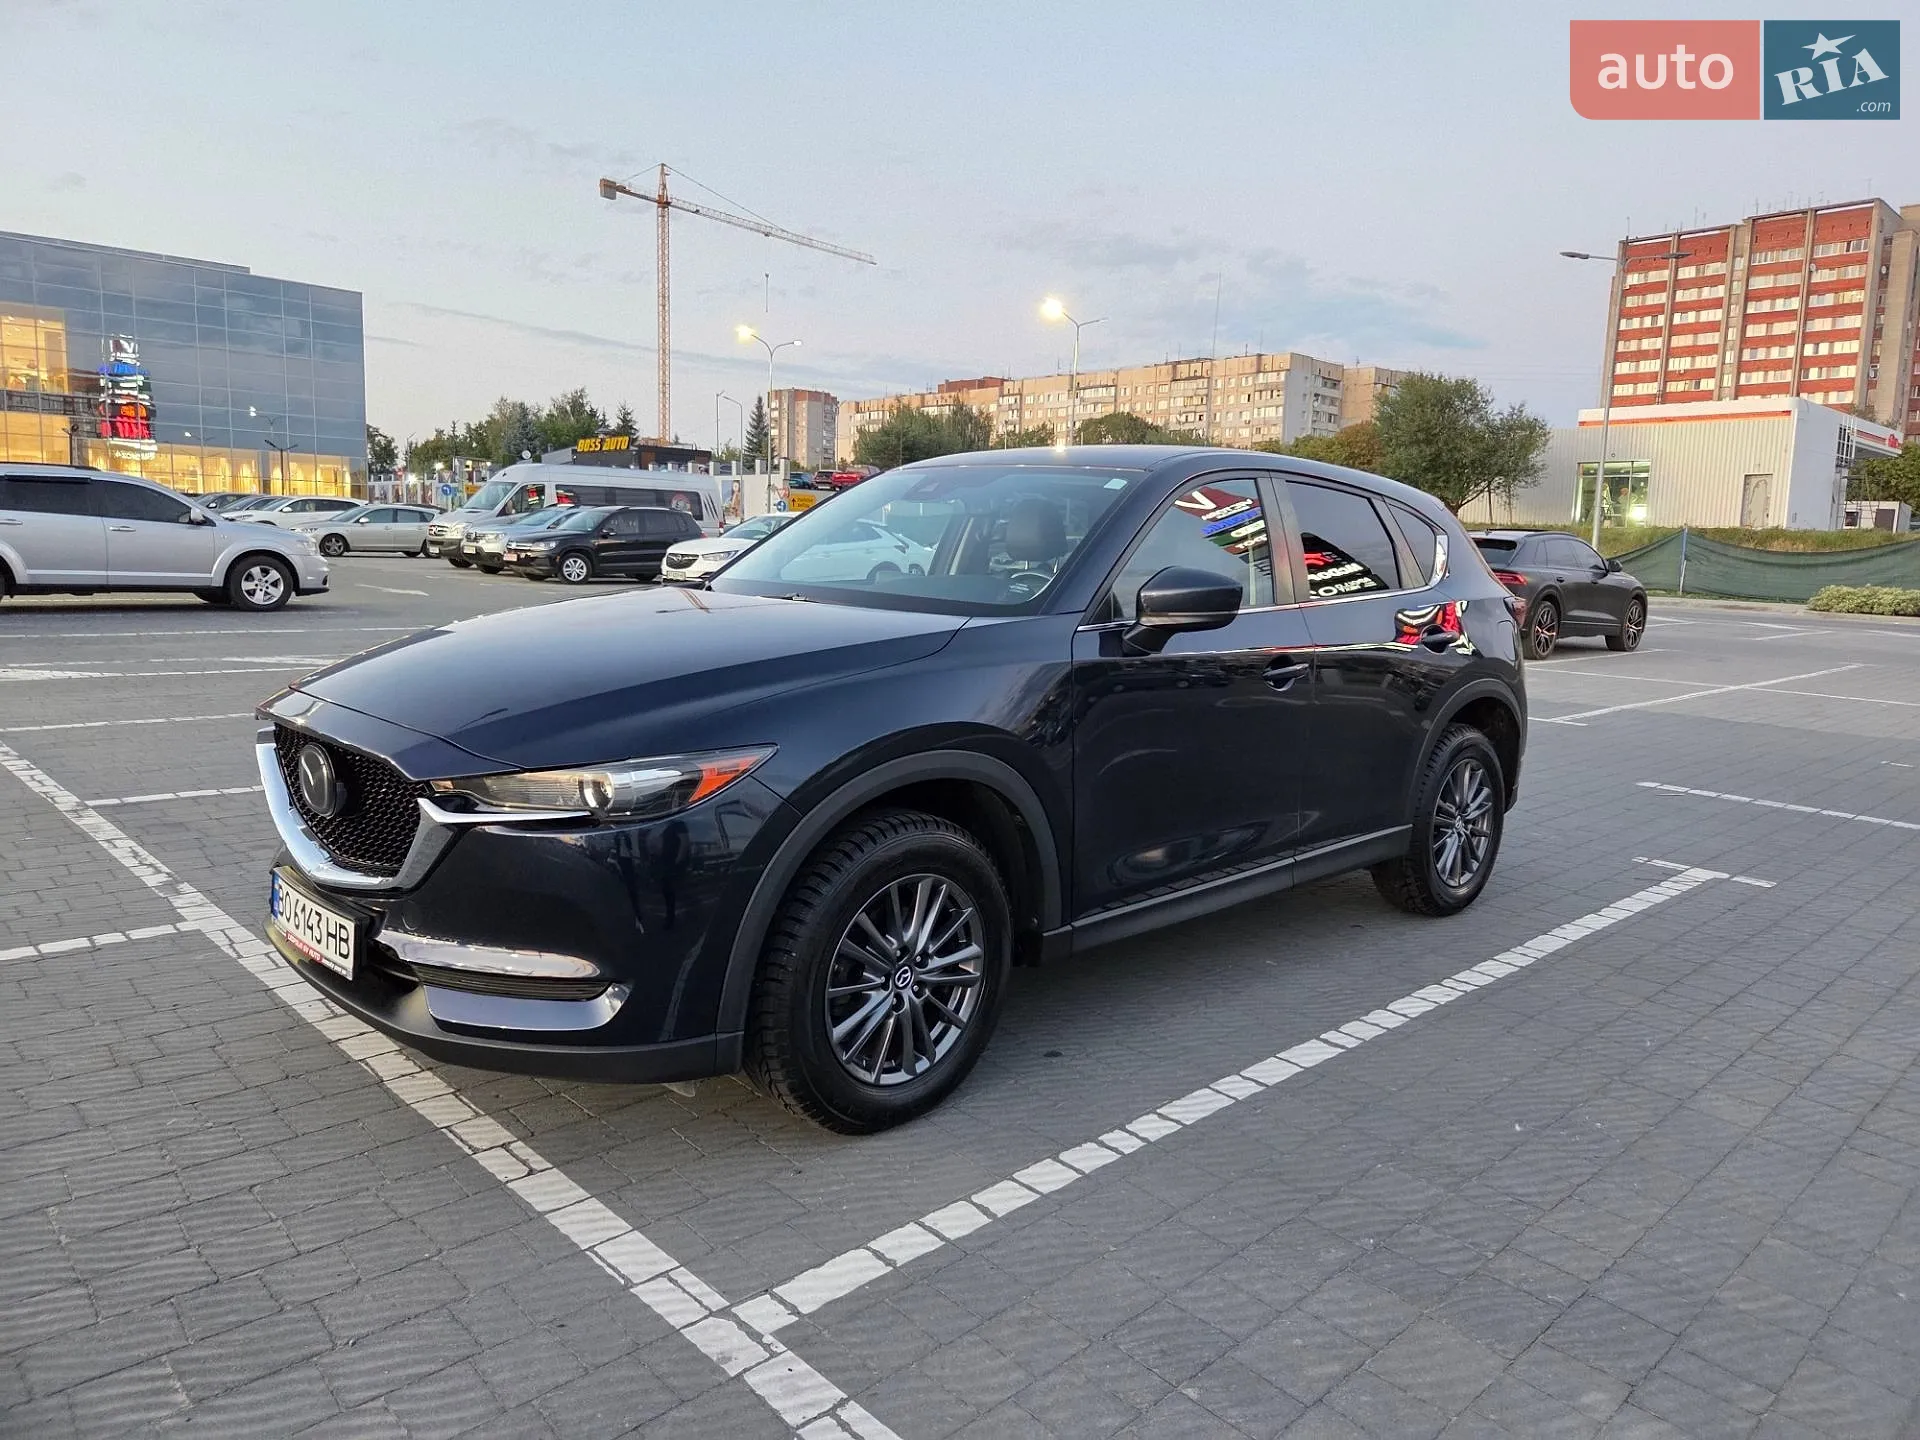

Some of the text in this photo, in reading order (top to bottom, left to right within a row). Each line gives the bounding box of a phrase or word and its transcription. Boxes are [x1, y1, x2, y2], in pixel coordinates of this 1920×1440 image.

[576, 435, 630, 452] BOSS AUTO
[293, 898, 323, 945] 6143
[325, 916, 350, 960] HB
